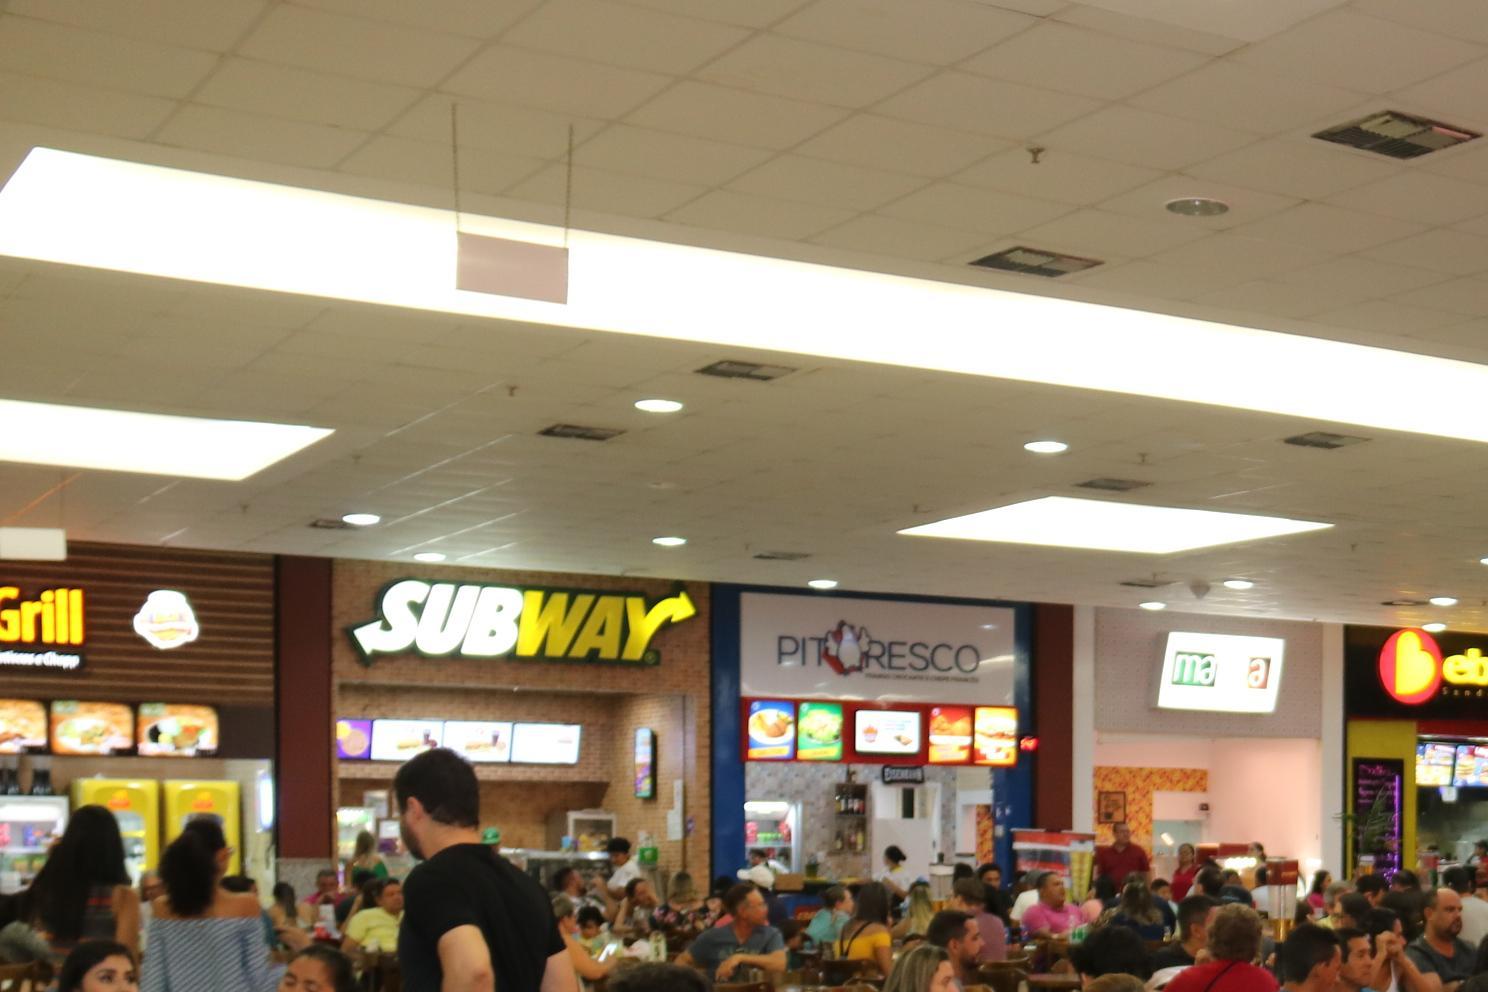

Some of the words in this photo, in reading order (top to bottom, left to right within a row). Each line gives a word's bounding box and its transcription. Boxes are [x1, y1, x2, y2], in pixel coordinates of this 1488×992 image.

[0, 586, 84, 645] Grill
[354, 580, 696, 661] SUBWAY
[777, 634, 980, 674] PITRESCO
